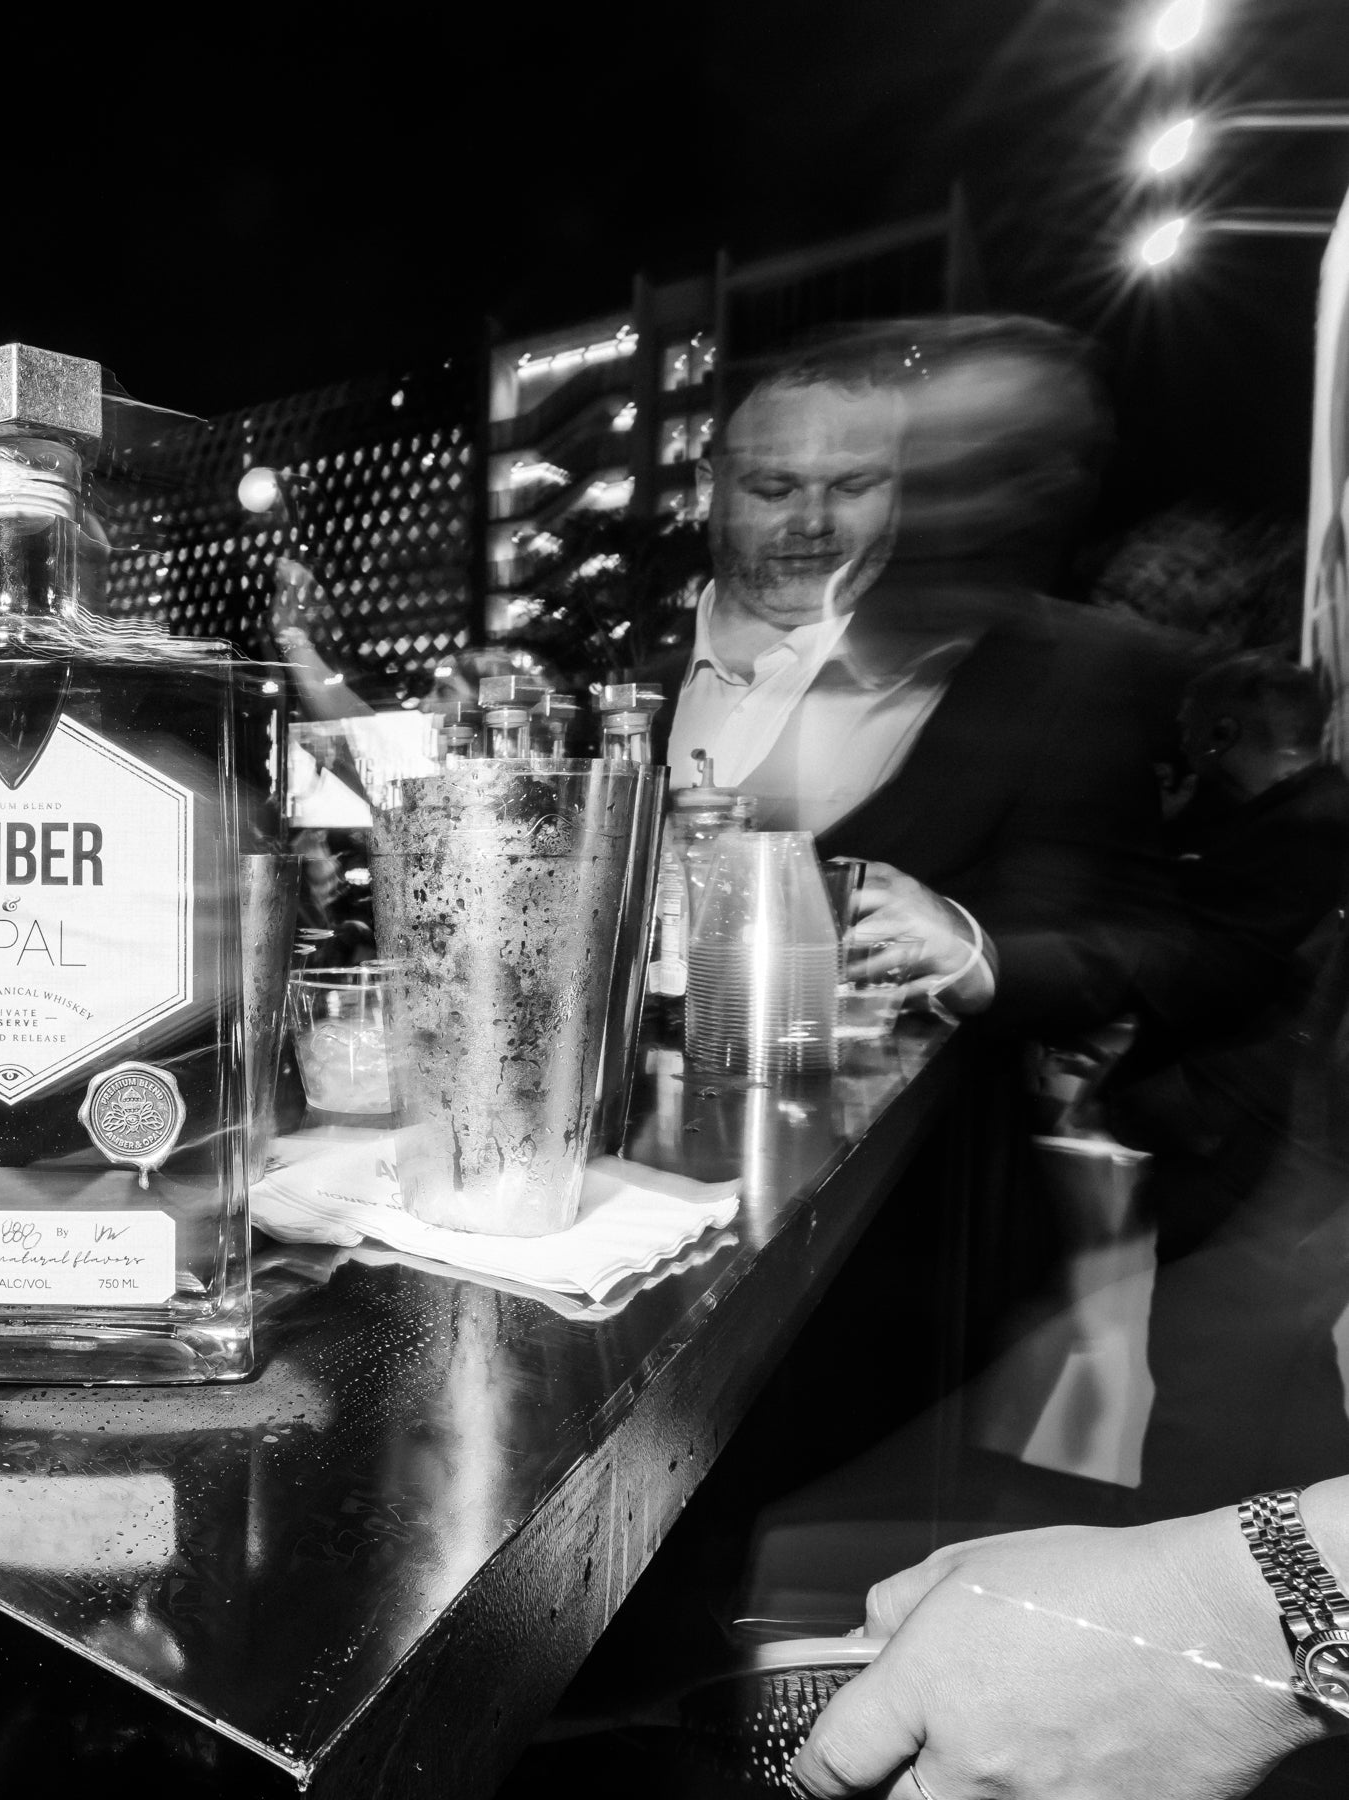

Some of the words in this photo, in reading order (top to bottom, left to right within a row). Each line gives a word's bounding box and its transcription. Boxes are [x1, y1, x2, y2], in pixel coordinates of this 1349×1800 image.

[22, 801, 63, 811] BLEND
[2, 894, 22, 912] &
[43, 990, 95, 1021] WHISKEY
[12, 1033, 67, 1043] RELEASE
[101, 1077, 137, 1105] PREMIUM
[138, 1078, 165, 1101] BLEND
[105, 1131, 134, 1150] AMBER
[135, 1140, 143, 1149] &
[144, 1130, 164, 1147] OPAL
[56, 1227, 69, 1239] By
[71, 1252, 146, 1268] flavors
[98, 1279, 119, 1290] 750
[122, 1279, 140, 1290] ML
